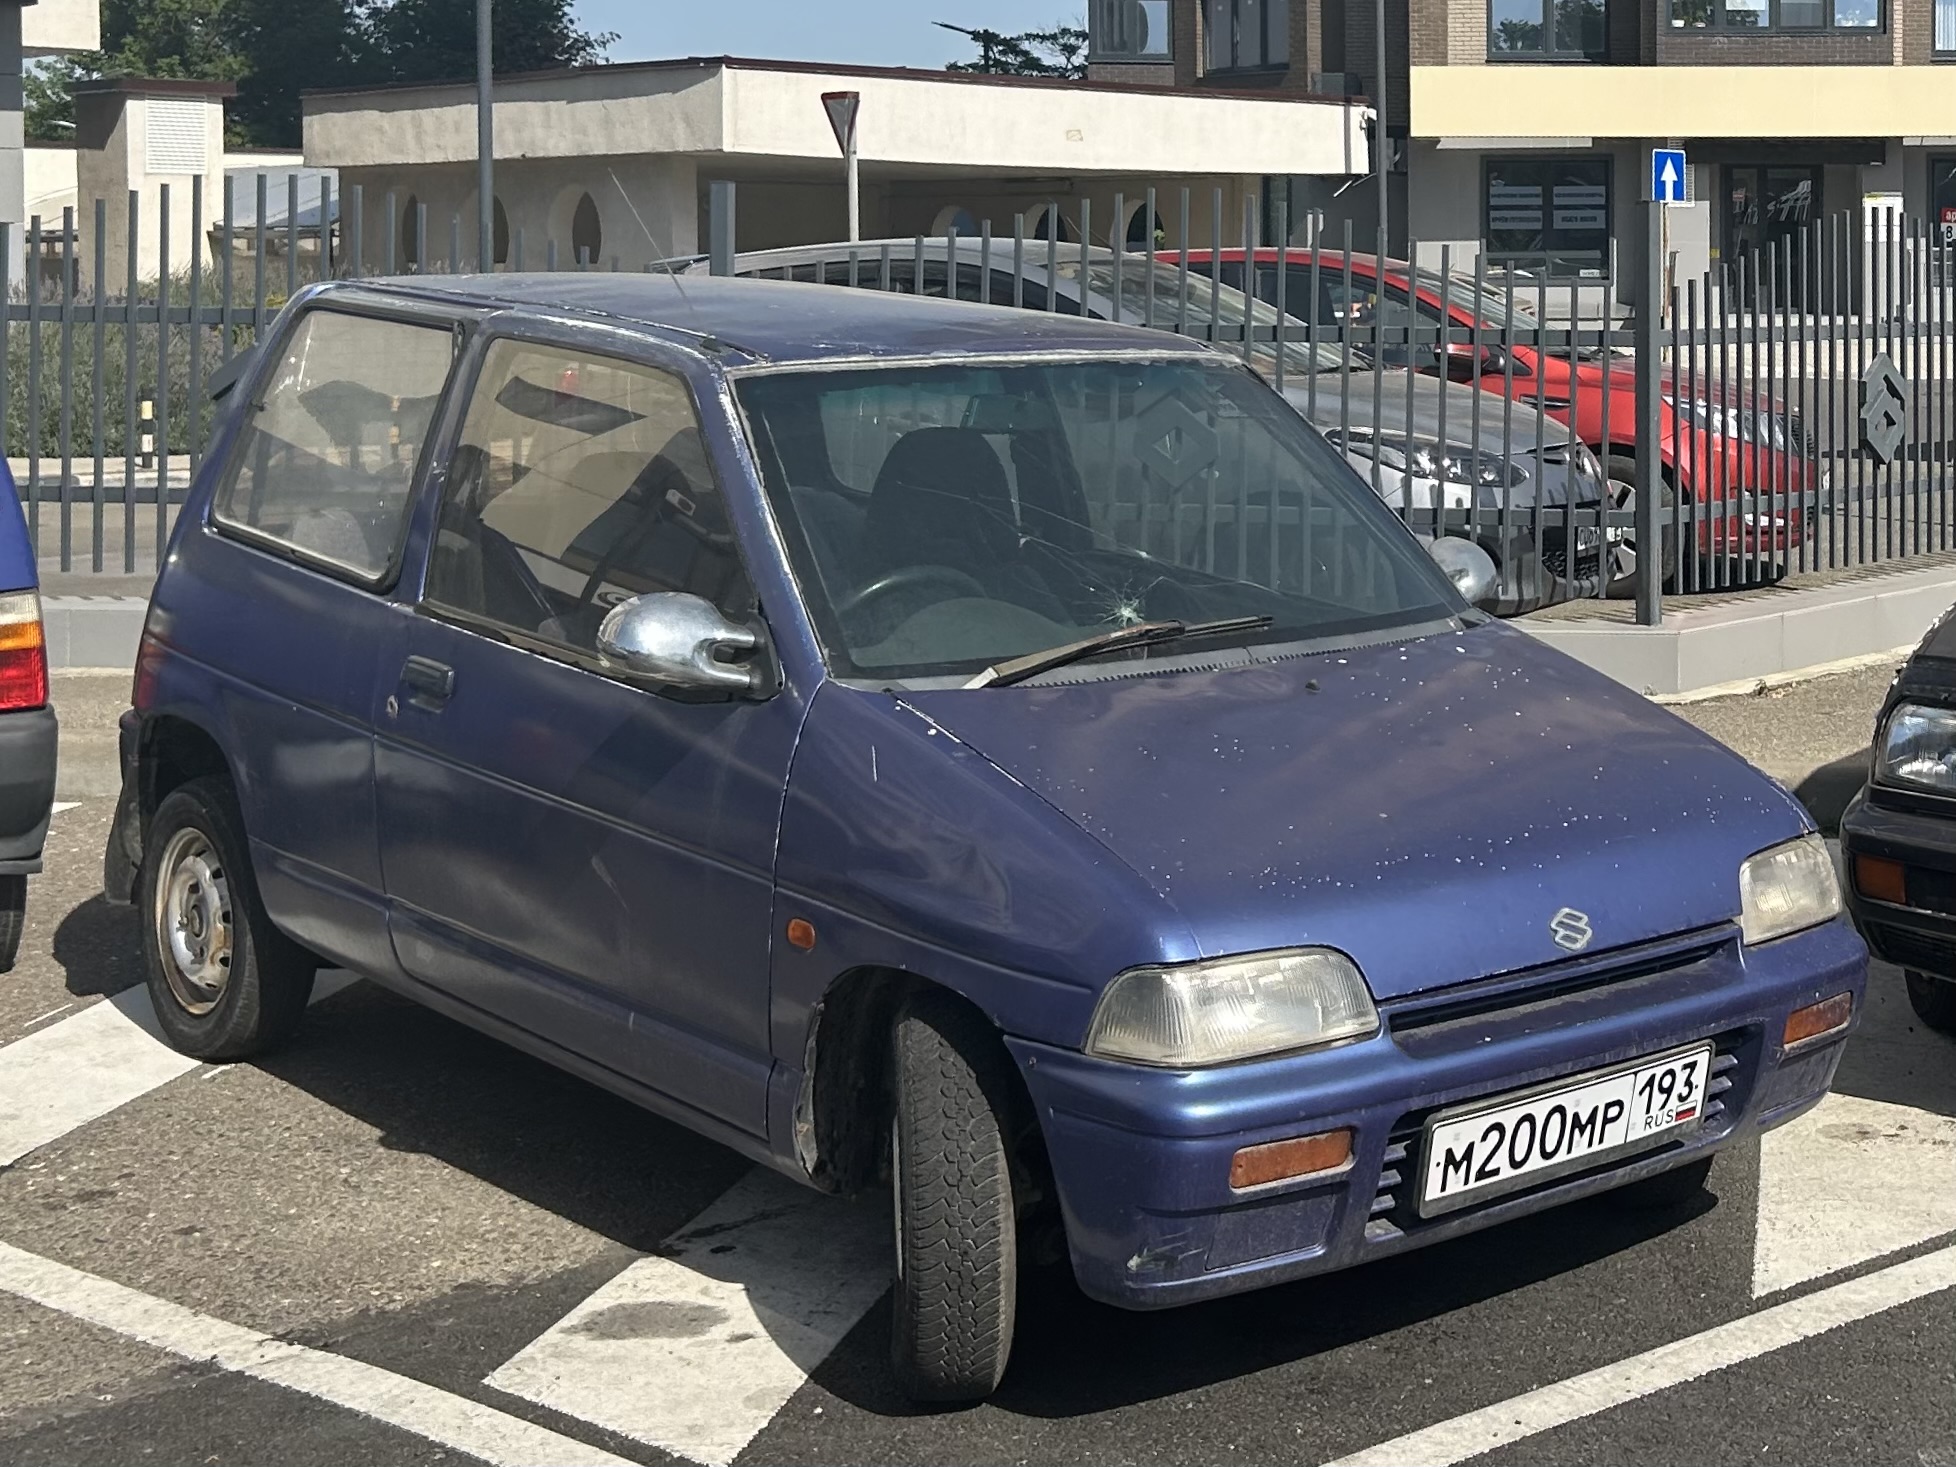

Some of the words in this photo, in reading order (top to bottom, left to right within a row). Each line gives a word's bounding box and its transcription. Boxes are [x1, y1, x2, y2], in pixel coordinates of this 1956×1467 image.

[1440, 1098, 1625, 1193] М200МР
[1638, 1060, 1698, 1115] 193
[1643, 1108, 1674, 1131] RUS
